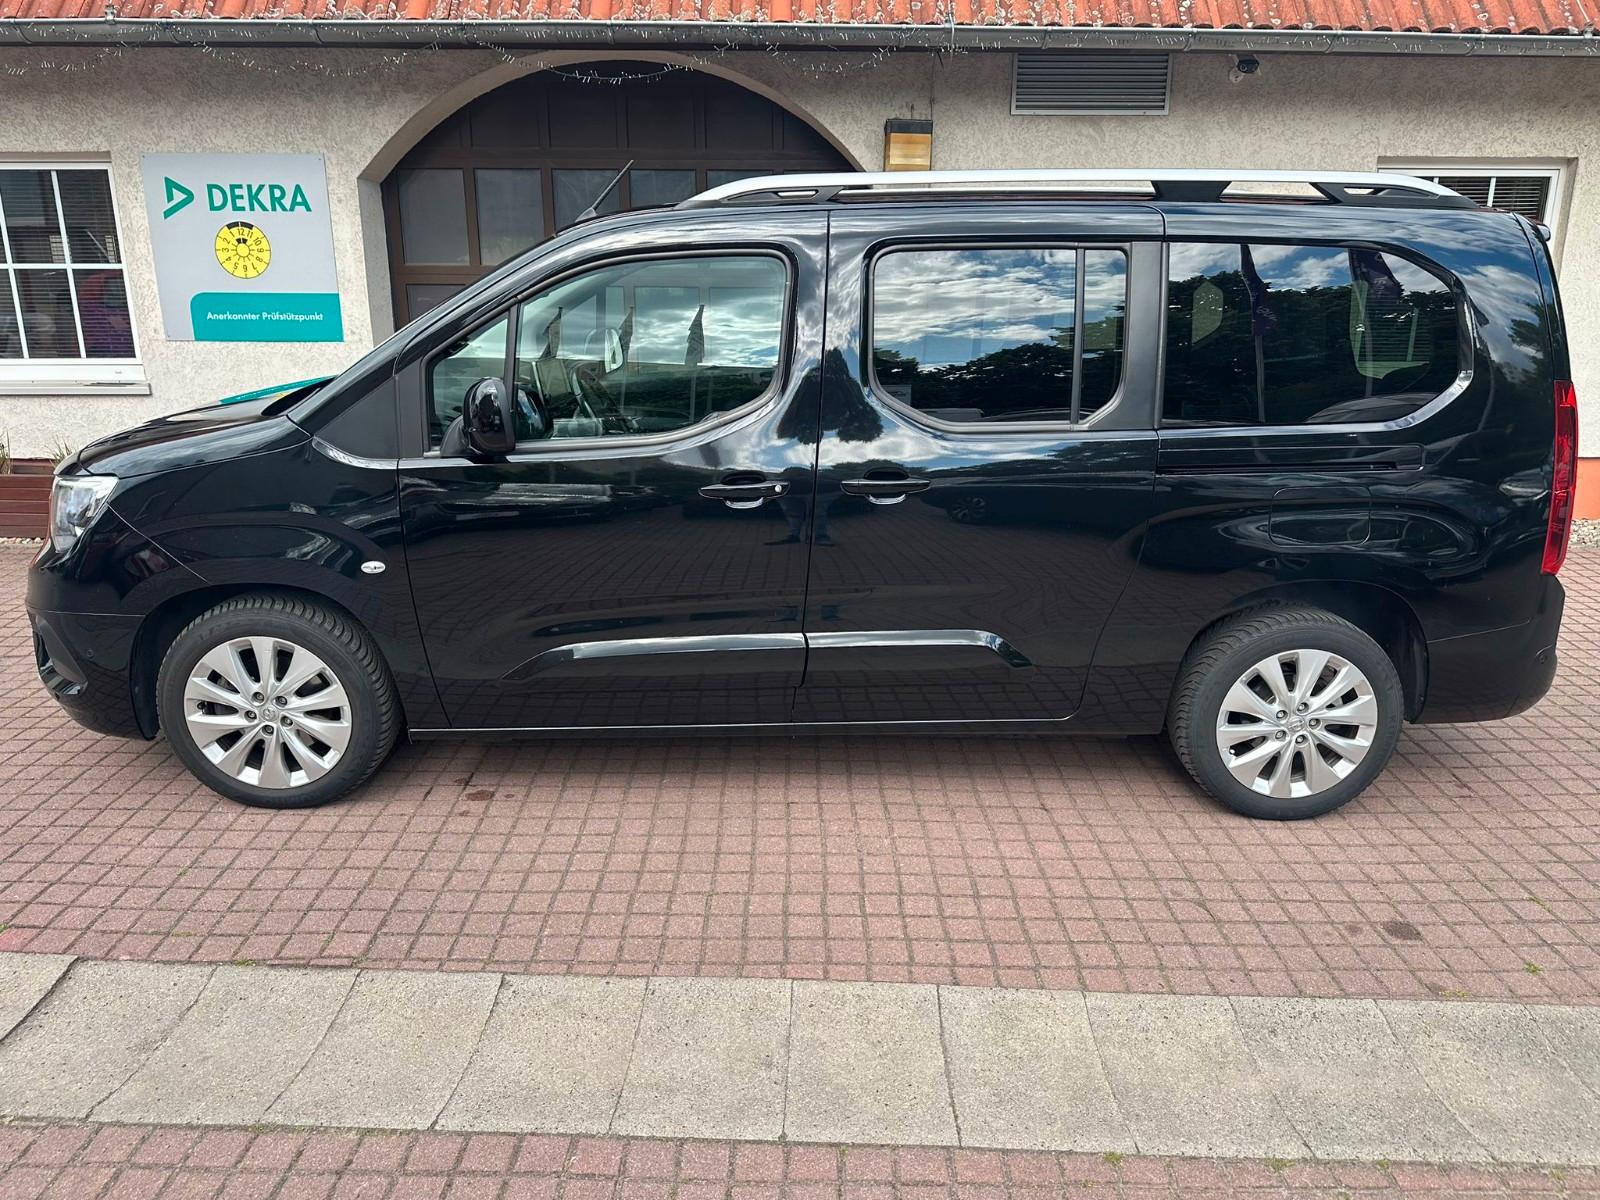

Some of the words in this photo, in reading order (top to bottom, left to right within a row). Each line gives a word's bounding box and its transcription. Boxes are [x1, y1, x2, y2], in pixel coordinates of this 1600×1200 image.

[206, 183, 313, 212] DEKRA
[206, 311, 260, 321] Anerkannter
[261, 311, 324, 323] Prüfstützpunkt
